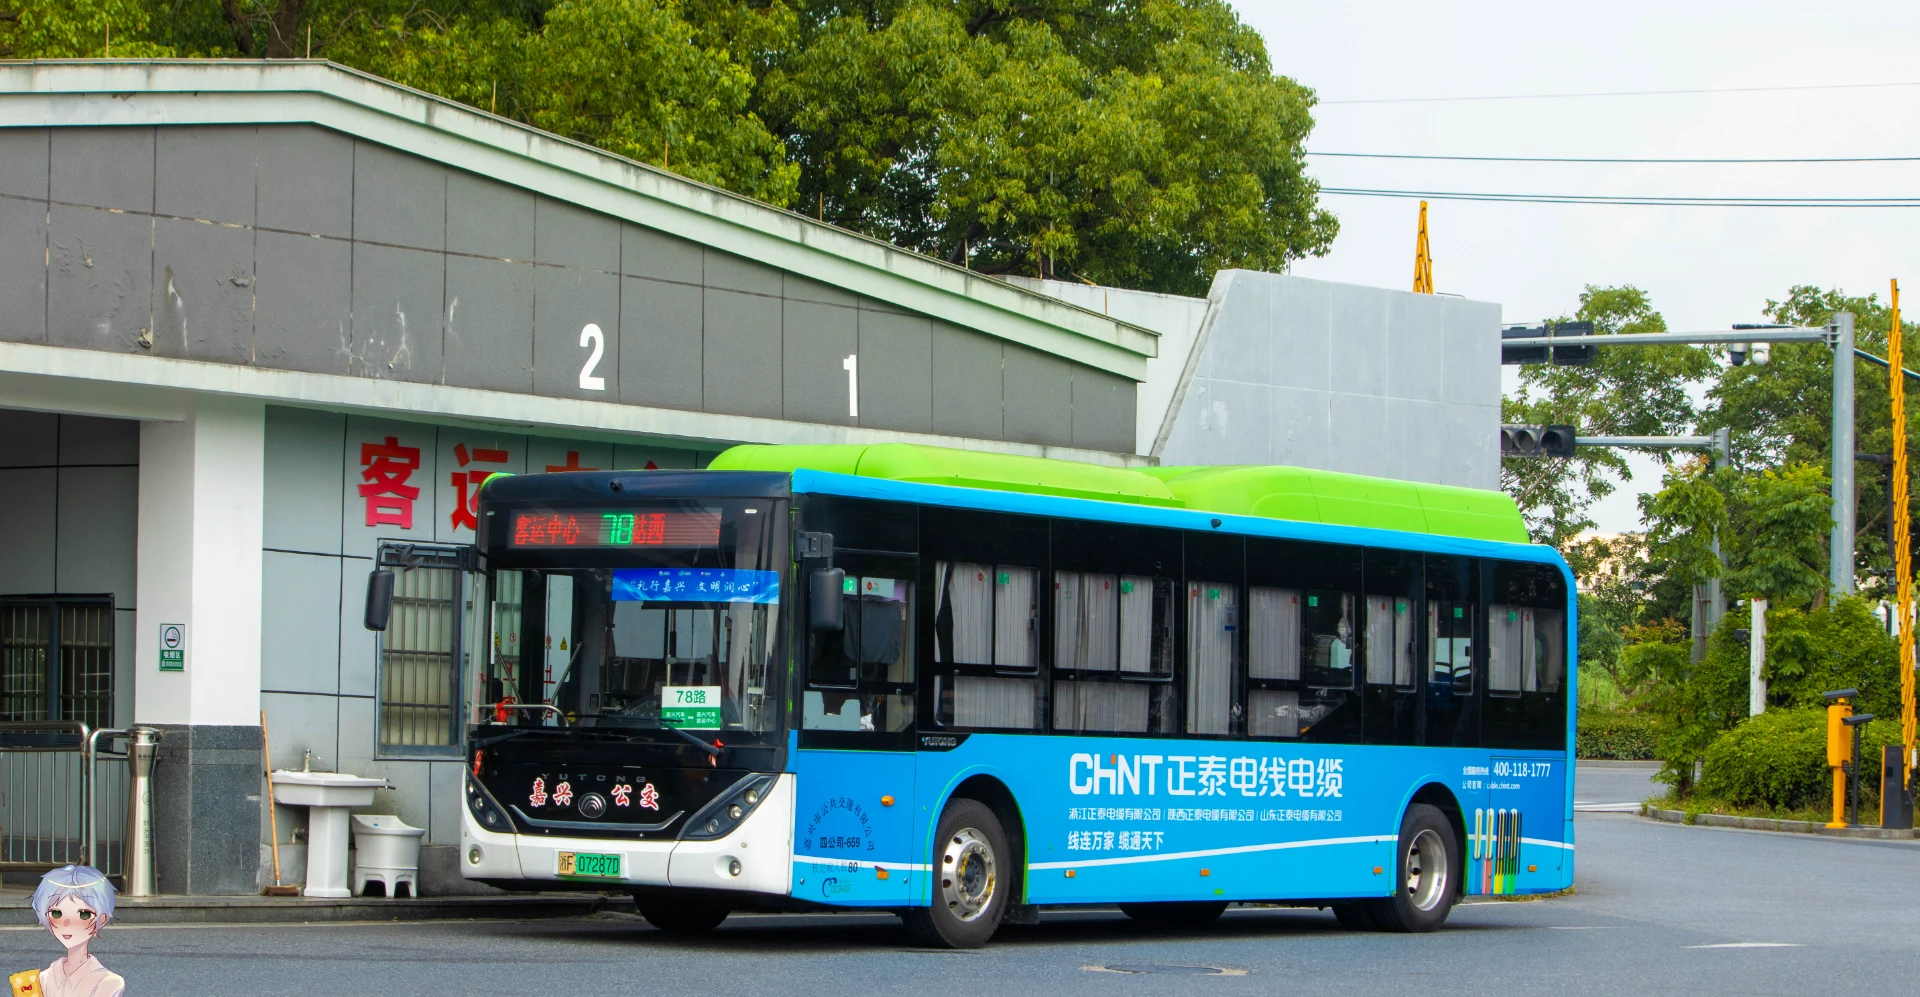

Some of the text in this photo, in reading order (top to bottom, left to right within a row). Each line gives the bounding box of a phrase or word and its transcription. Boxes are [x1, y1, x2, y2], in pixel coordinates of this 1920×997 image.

[579, 323, 605, 390] 2
[843, 354, 857, 416] 1
[515, 514, 580, 545] 客运中心
[603, 514, 634, 545] 78
[676, 690, 706, 704] 78路
[541, 773, 646, 783] YUTONG
[1167, 755, 1344, 798] 正泰电线电缆
[1493, 762, 1551, 777] 400-118-1777
[529, 777, 659, 811] 嘉兴 公交
[1068, 808, 1342, 822] 浙江正泰电缆有限公司 陕西正泰电缆有限公司 山东正泰电缆有限公司
[819, 836, 861, 849] 四公司-659
[1067, 831, 1164, 851] 线连万家 缆通天下
[830, 884, 852, 894] 12345
